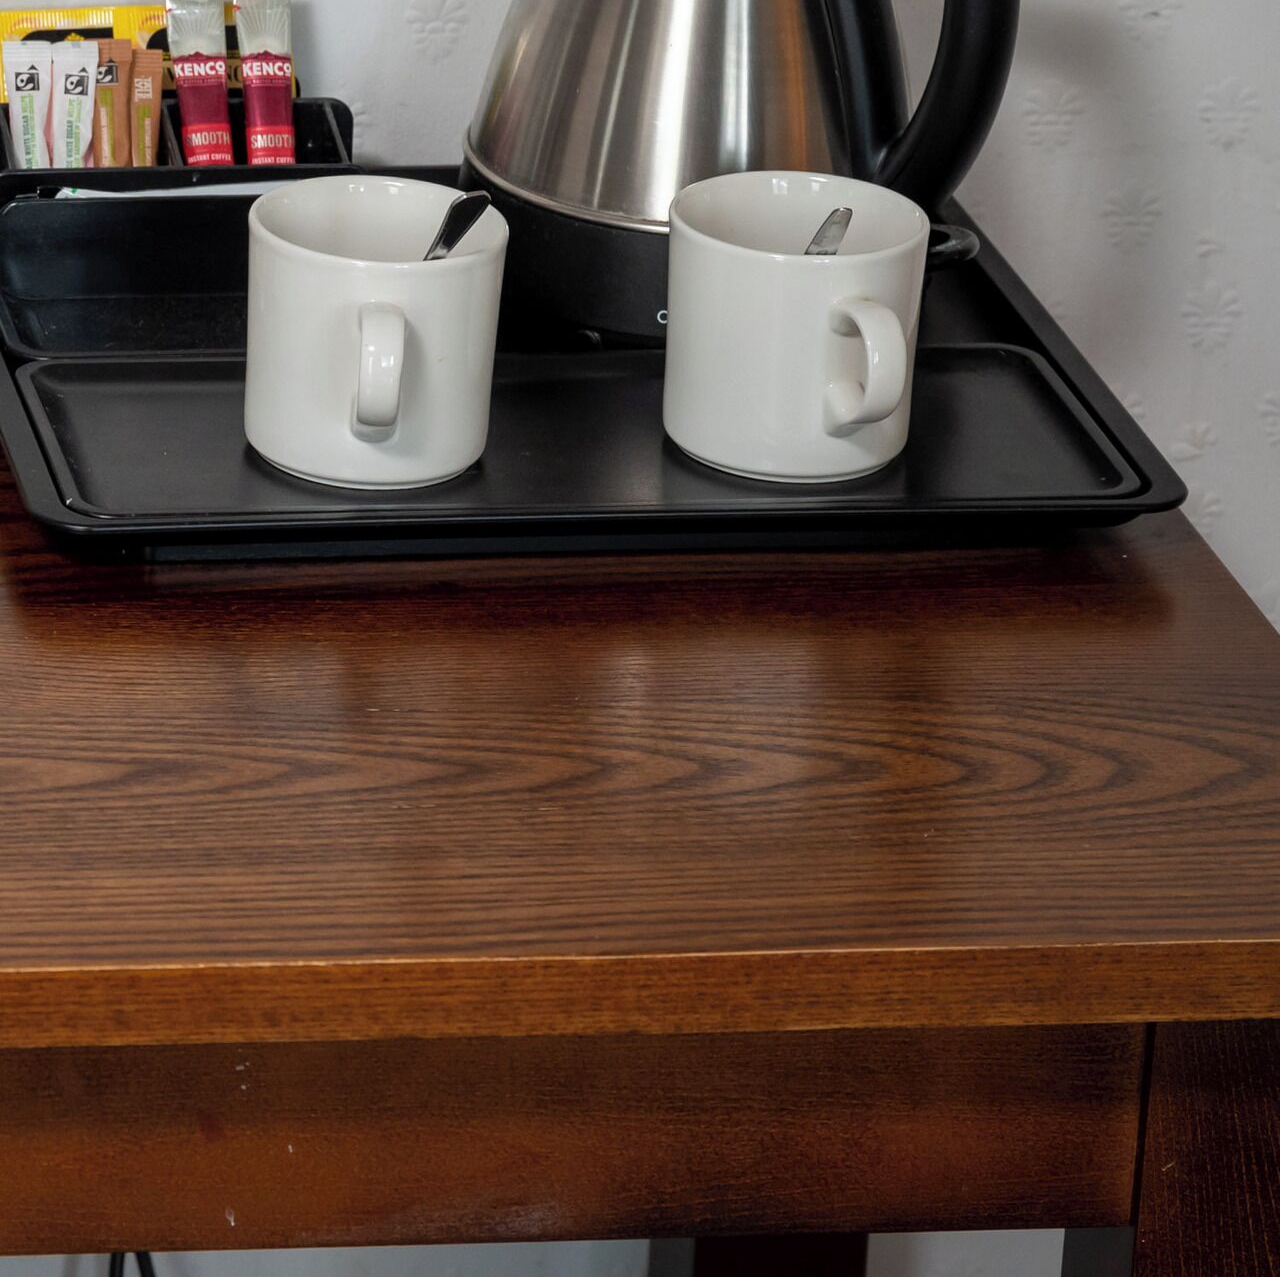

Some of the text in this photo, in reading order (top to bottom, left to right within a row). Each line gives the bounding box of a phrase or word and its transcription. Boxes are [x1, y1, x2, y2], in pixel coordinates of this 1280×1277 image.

[174, 61, 226, 78] KENCO
[243, 61, 292, 77] KENCO
[186, 131, 230, 147] SMOOTH
